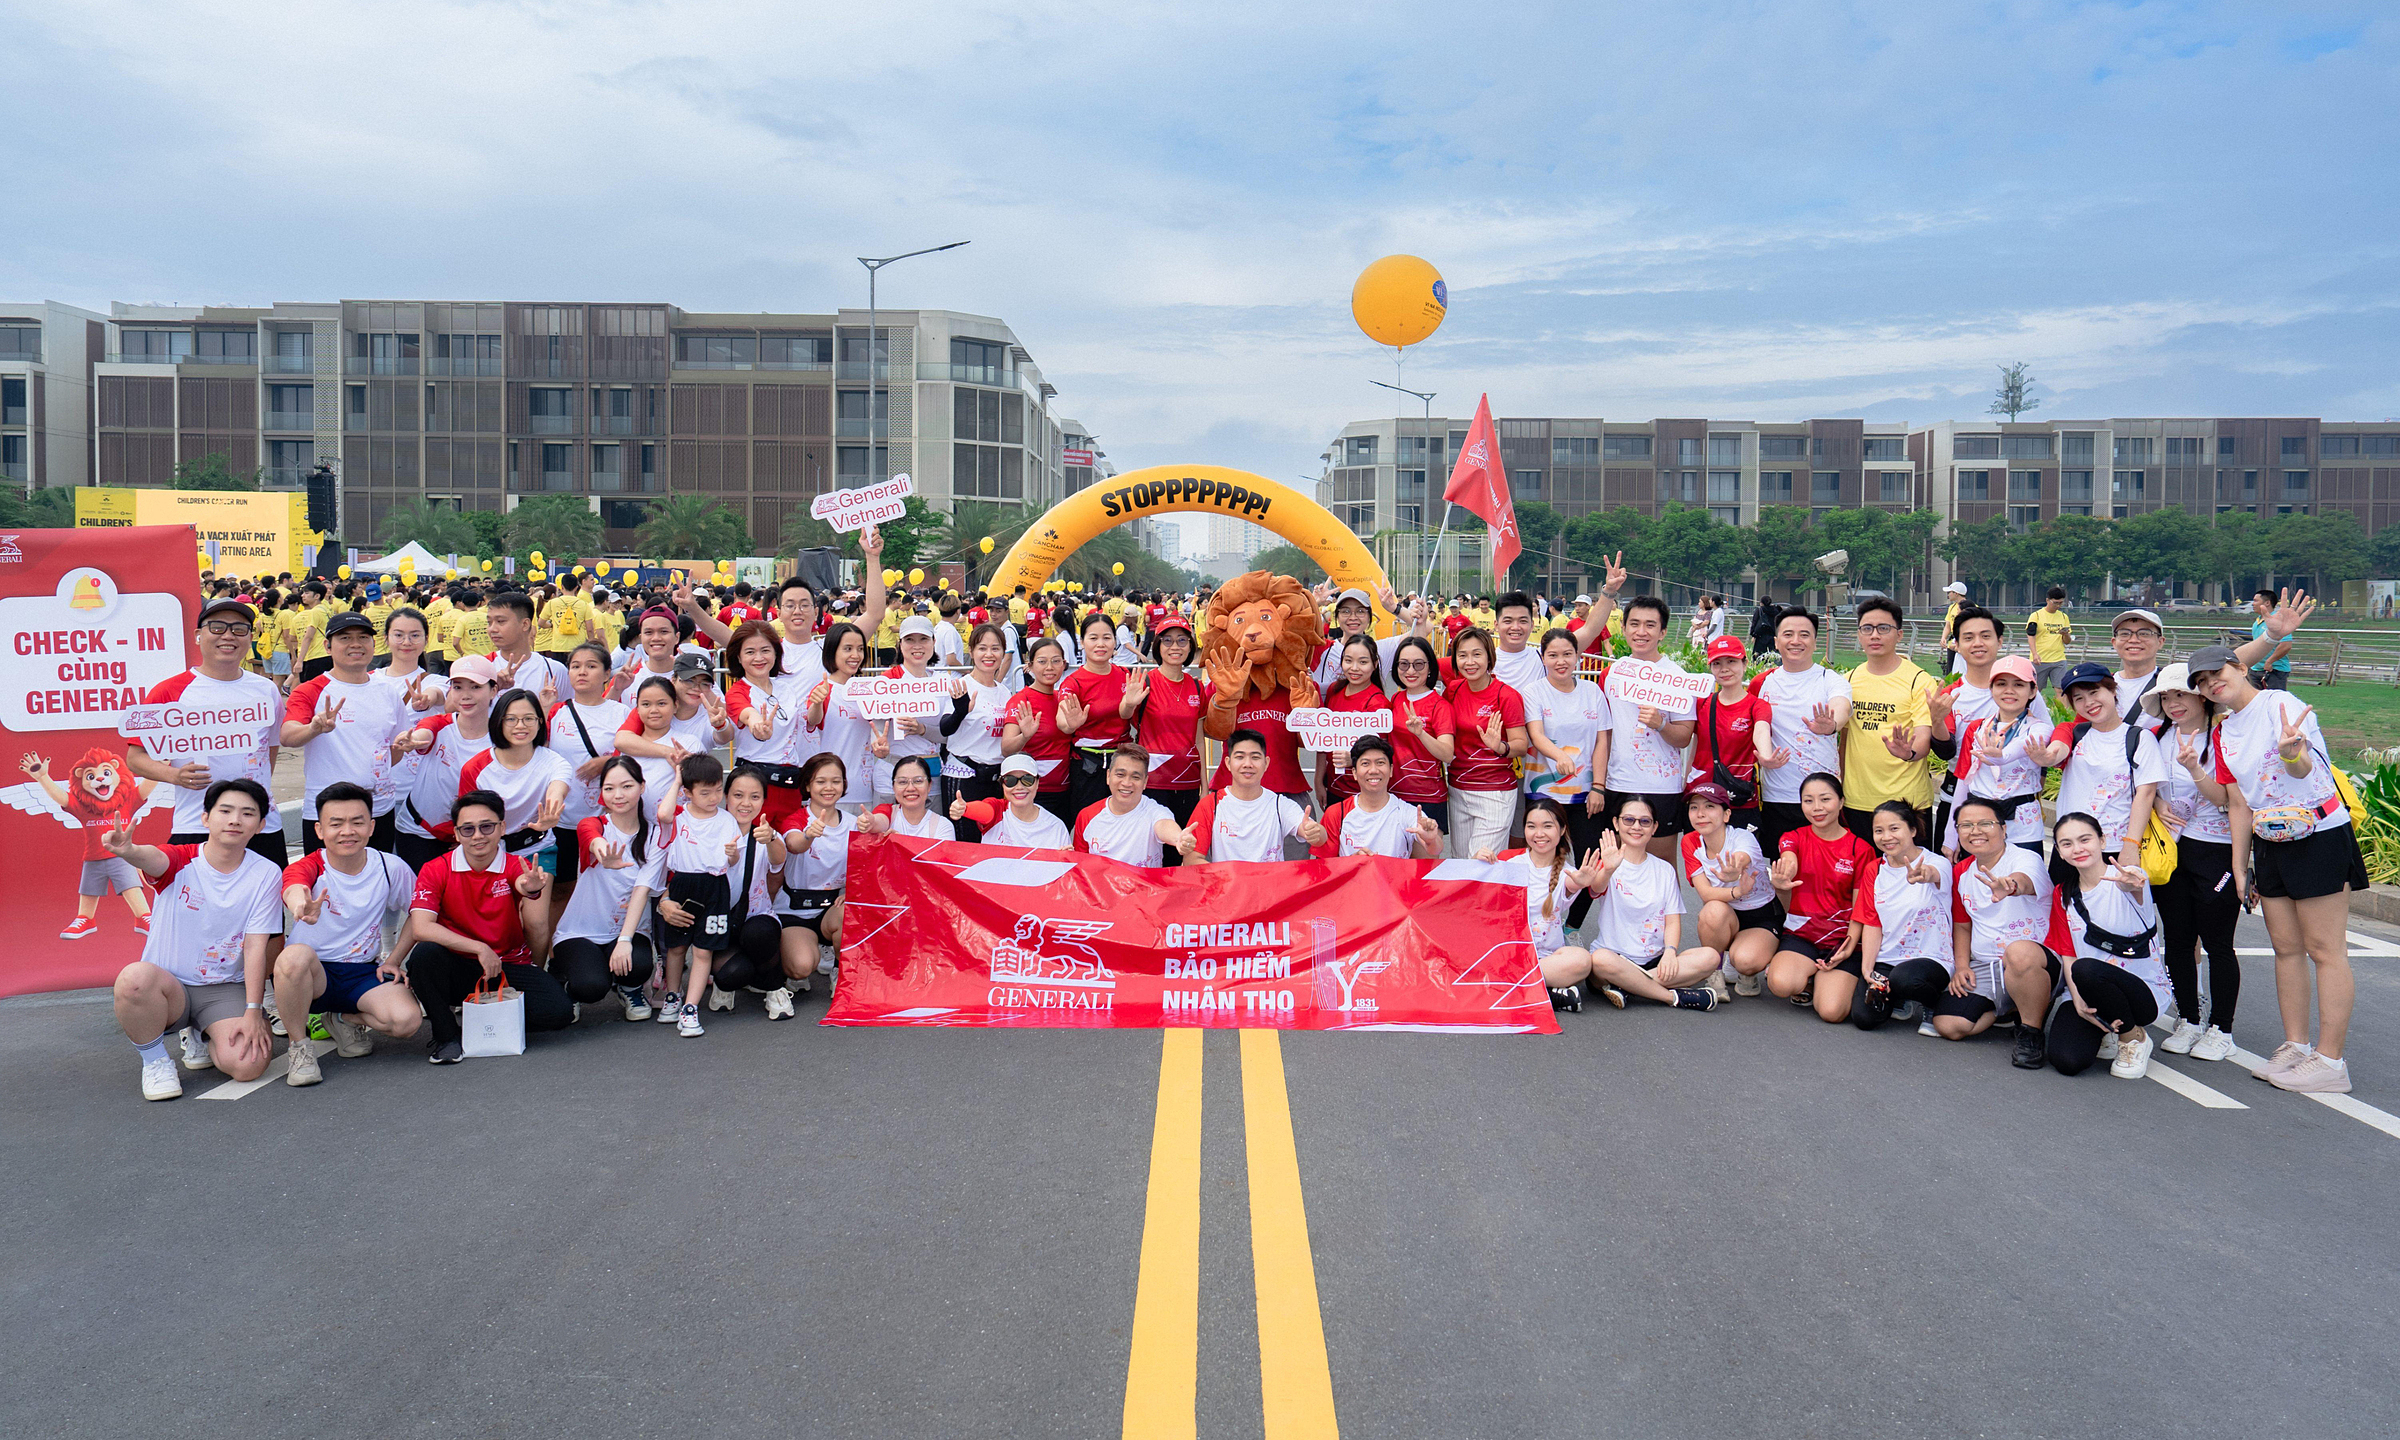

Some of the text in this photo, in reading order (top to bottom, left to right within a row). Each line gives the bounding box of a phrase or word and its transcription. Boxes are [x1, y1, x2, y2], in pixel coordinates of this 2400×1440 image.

[1465, 456, 1487, 470] GENE
[177, 497, 210, 505] CHILDREN'S
[839, 477, 910, 508] Generali
[1100, 477, 1273, 521] STOPPPPPPP!
[80, 517, 133, 527] CHILDREN'S
[831, 501, 902, 531] Vietnam
[230, 528, 252, 541] XUẤT
[254, 530, 276, 542] PHÁT
[1033, 539, 1065, 550] CANCHAM
[249, 547, 272, 557] AREA
[14, 629, 108, 656] CHECK
[138, 627, 166, 652] IN
[58, 657, 127, 685] cùng
[1638, 664, 1711, 695] Generali
[873, 677, 949, 696] Generali
[1622, 681, 1689, 711] Vietnam
[26, 686, 148, 715] GENERAL
[862, 698, 936, 716] Vietnam
[1852, 700, 1896, 713] CHILDREN'S
[163, 702, 269, 728] Generali
[1251, 709, 1286, 722] GENER
[1316, 712, 1389, 728] Generali
[1862, 721, 1879, 731] RUN
[148, 729, 253, 756] Vietnam
[1305, 731, 1359, 747] Vietna
[96, 818, 129, 826] GENEALI
[705, 914, 728, 935] 65
[1166, 921, 1290, 948] GENERALI
[1164, 947, 1291, 980] BẢO HIỂM
[987, 986, 1114, 1010] GENERALI
[1162, 985, 1238, 1010] NHÂN
[1355, 998, 1376, 1007] 1831
